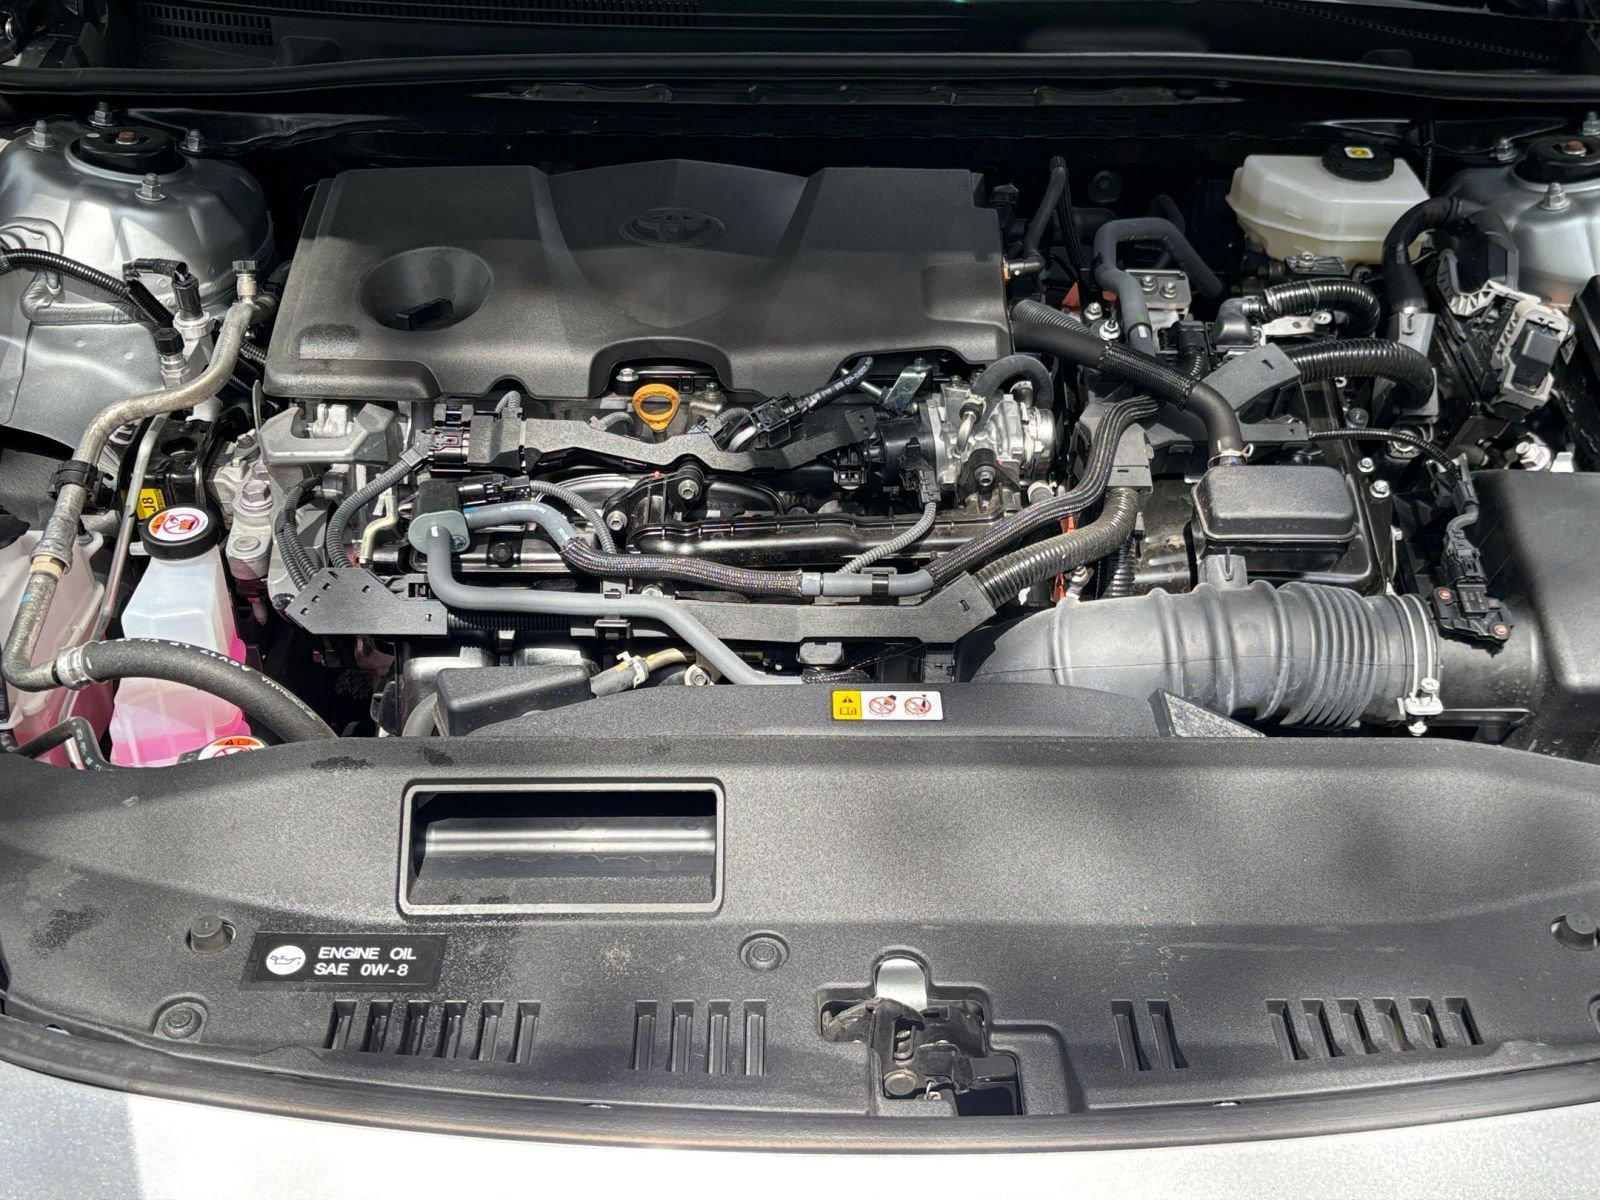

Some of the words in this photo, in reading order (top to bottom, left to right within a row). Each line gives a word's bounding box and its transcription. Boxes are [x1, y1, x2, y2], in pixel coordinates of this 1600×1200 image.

[142, 497, 156, 512] J8
[262, 676, 305, 710] YOKOHAMA
[318, 946, 380, 960] ENGINE
[389, 947, 417, 960] OIL
[313, 963, 350, 976] SAE
[360, 963, 409, 977] 0W-8
